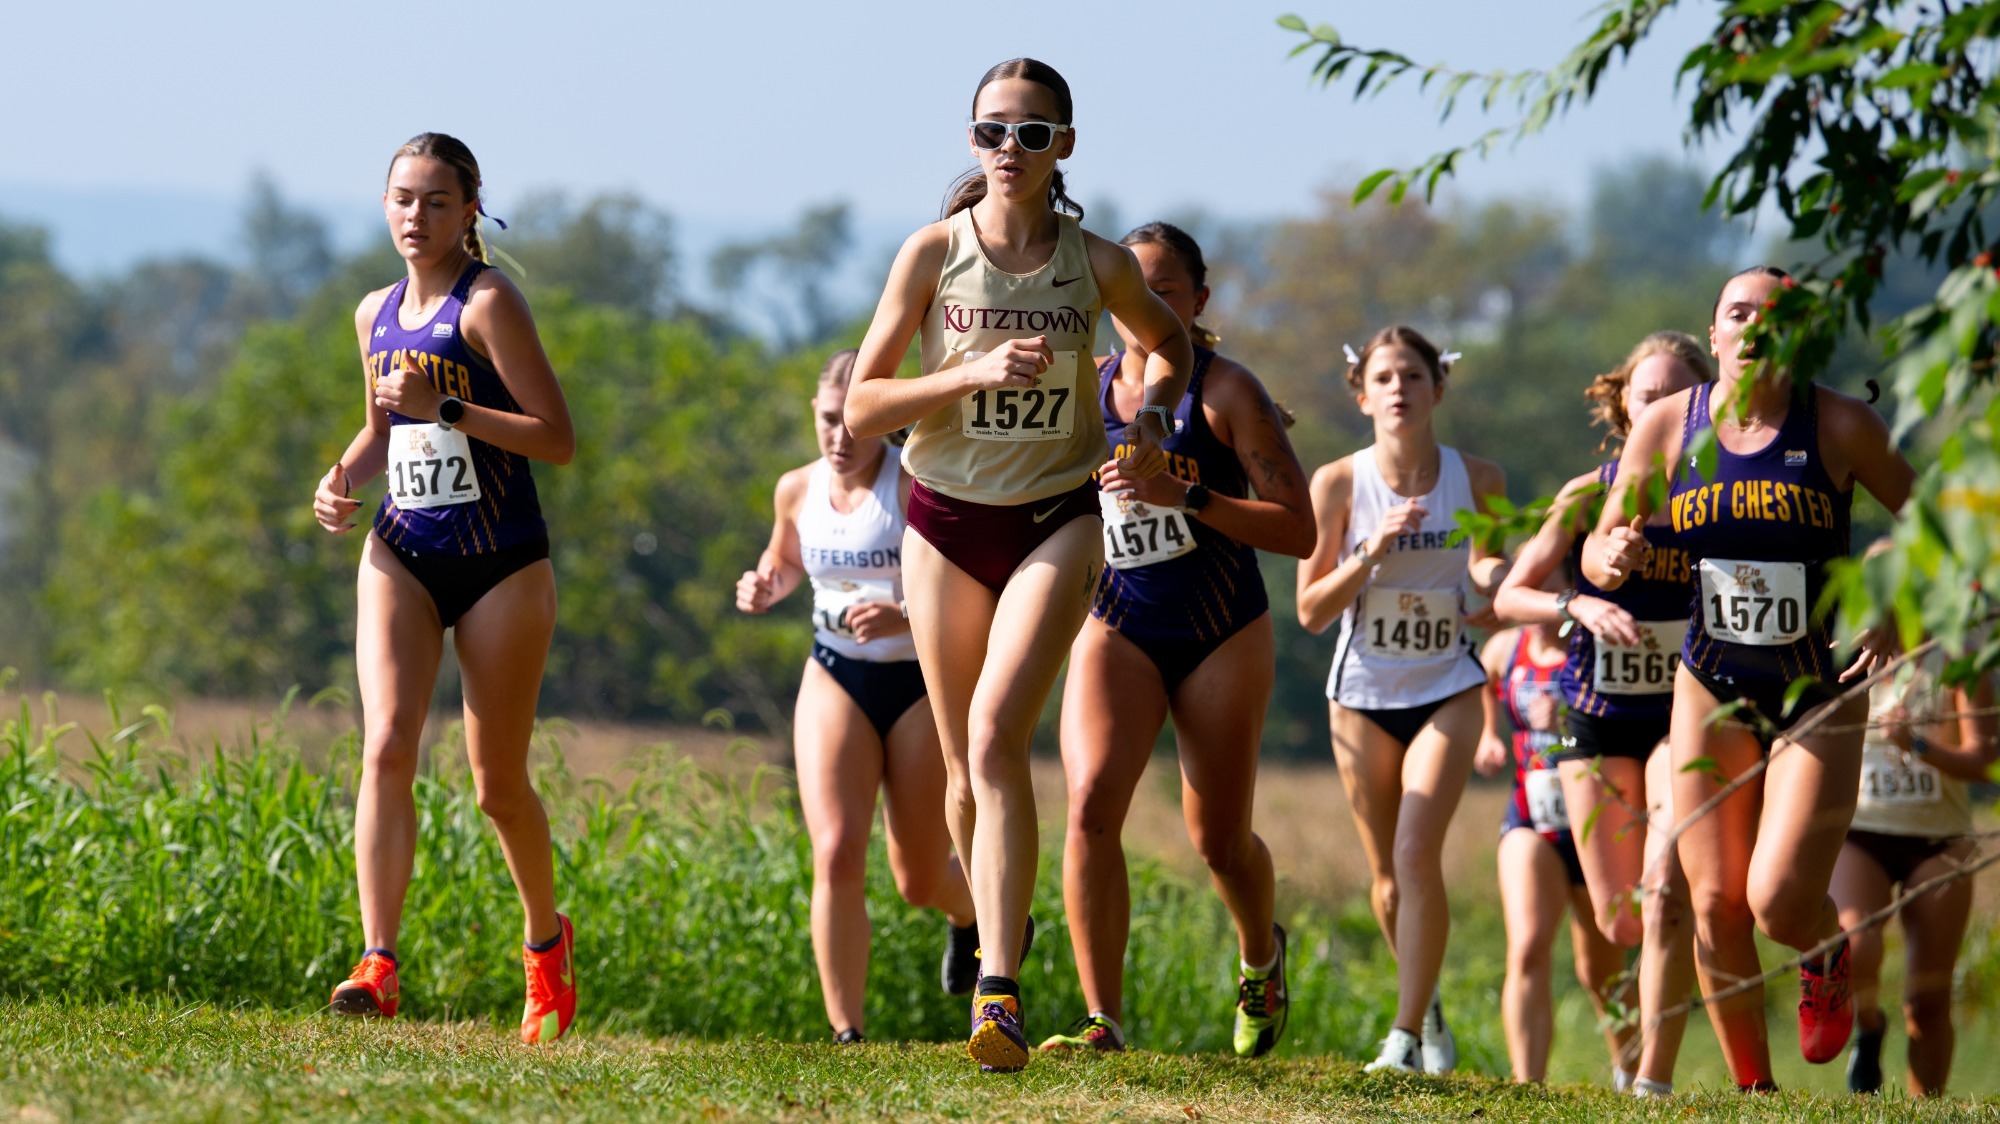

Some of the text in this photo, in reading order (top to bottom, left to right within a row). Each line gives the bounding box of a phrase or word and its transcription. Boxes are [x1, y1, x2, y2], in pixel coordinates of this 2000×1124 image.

[943, 304, 1092, 335] KUTZTOWN
[971, 388, 1070, 429] 1527
[395, 456, 472, 497] 1572
[1671, 480, 1834, 534] WEST CHESTER
[1107, 514, 1185, 558] 1574
[803, 546, 902, 569] EFFERSON
[1372, 617, 1451, 651] 1496
[1711, 593, 1799, 634] 1570
[1600, 651, 1682, 684] 1569
